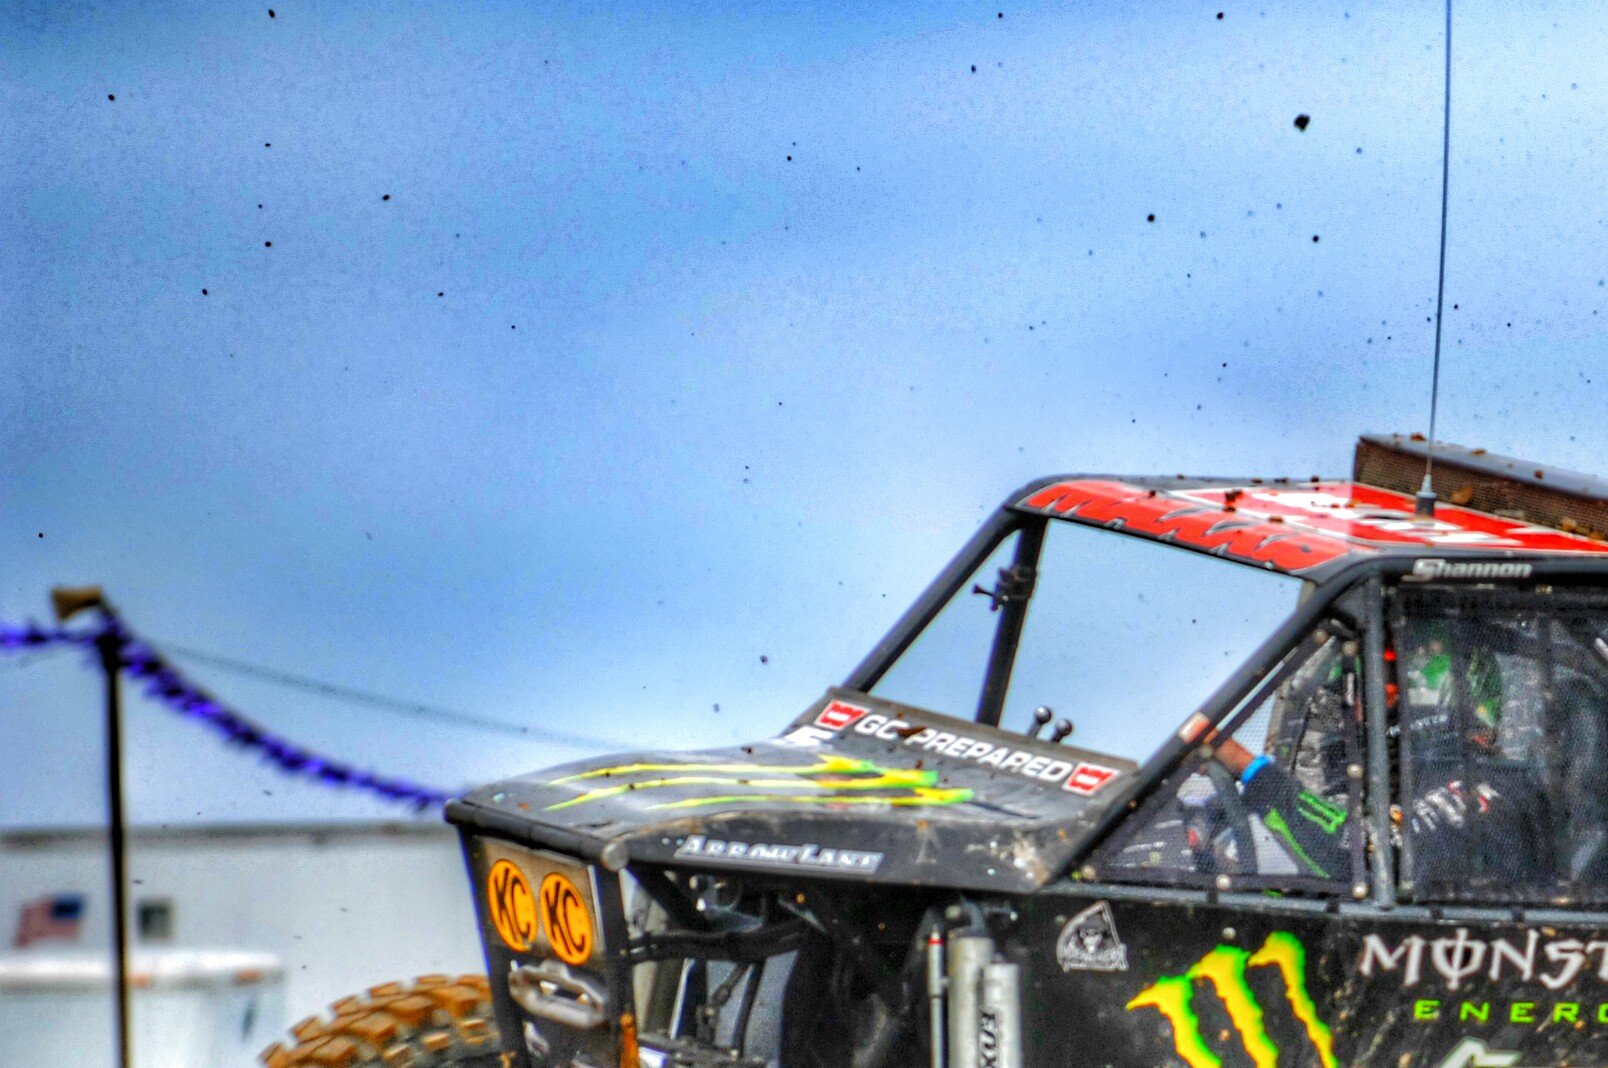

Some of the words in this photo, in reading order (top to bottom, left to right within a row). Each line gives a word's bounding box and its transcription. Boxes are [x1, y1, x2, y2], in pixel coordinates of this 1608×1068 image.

[1404, 558, 1532, 582] Shannon
[854, 713, 910, 741] GC
[904, 727, 1075, 783] PREPARED
[494, 867, 531, 942] KC
[545, 880, 585, 955] KC
